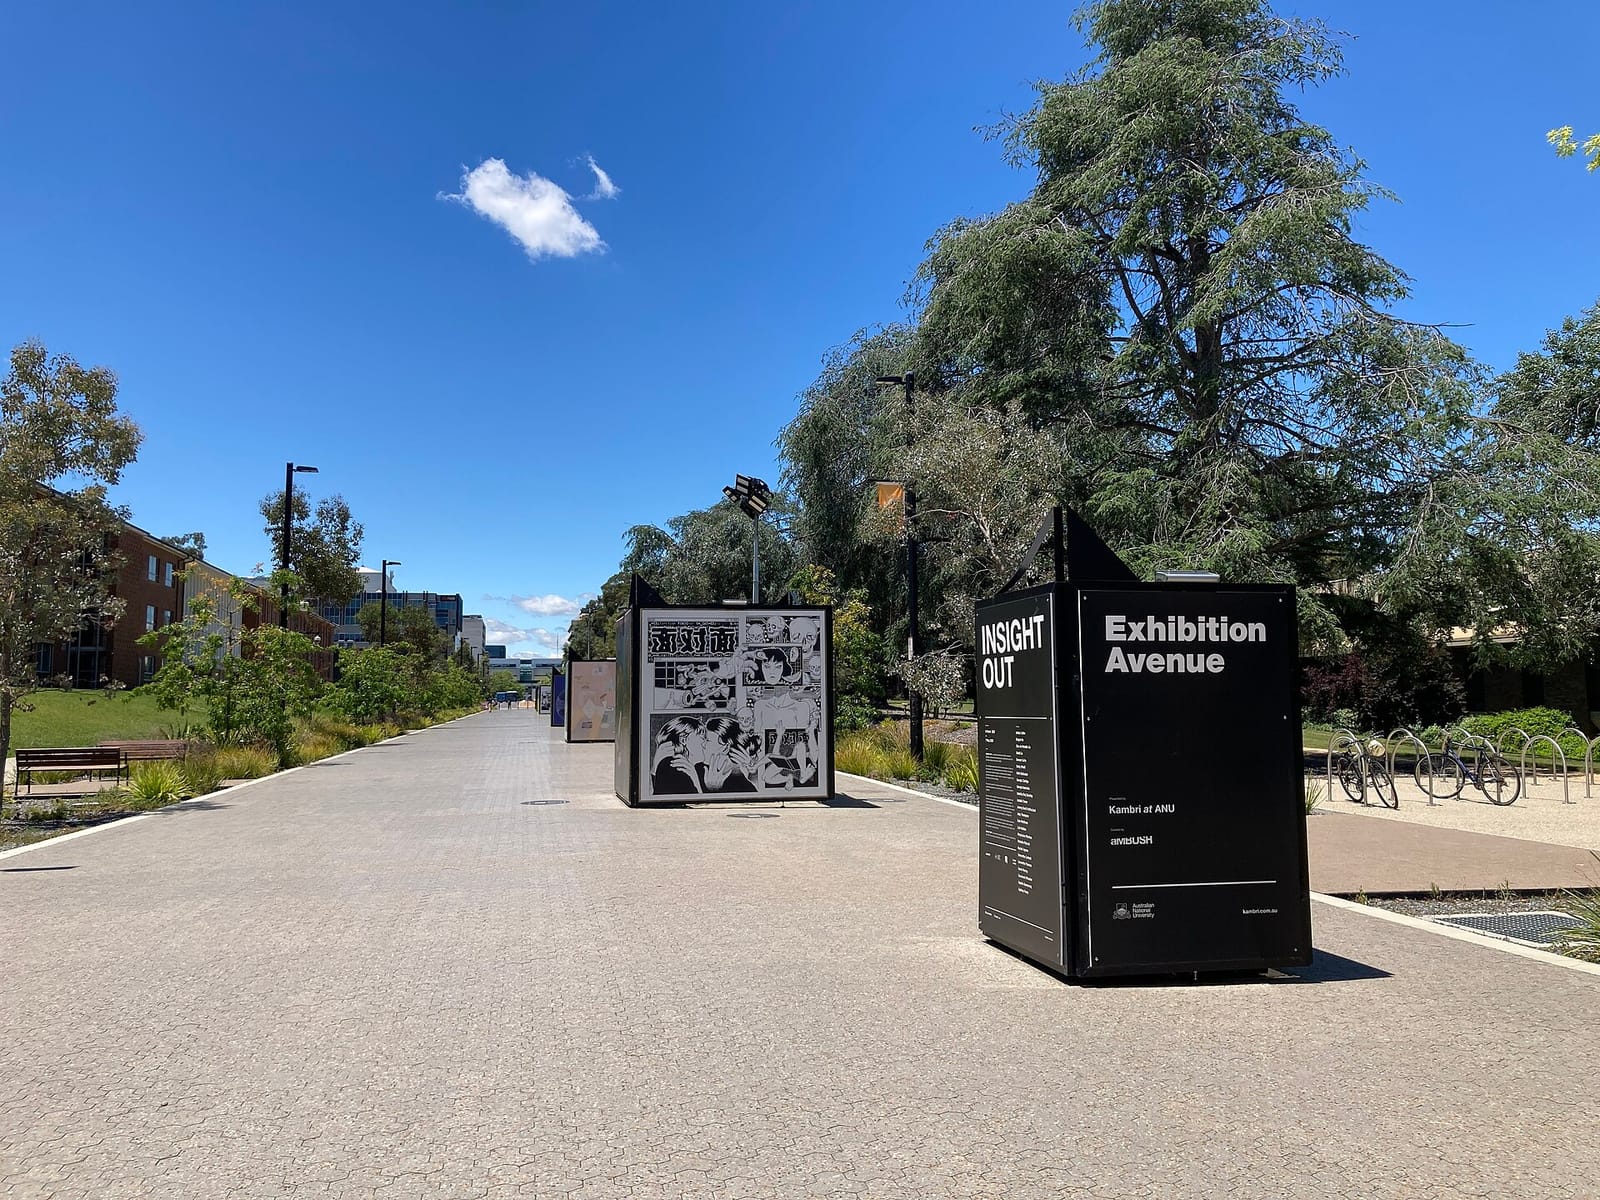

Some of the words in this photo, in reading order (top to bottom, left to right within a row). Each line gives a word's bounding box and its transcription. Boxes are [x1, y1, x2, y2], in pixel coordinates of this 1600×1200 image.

[982, 615, 1044, 655] INSIGHT
[1105, 615, 1267, 642] Exhibition
[982, 656, 1014, 689] OUT
[1104, 647, 1225, 673] Avenue
[1109, 804, 1141, 814] Kambri
[1143, 805, 1153, 814] at
[1154, 803, 1175, 813] ANU
